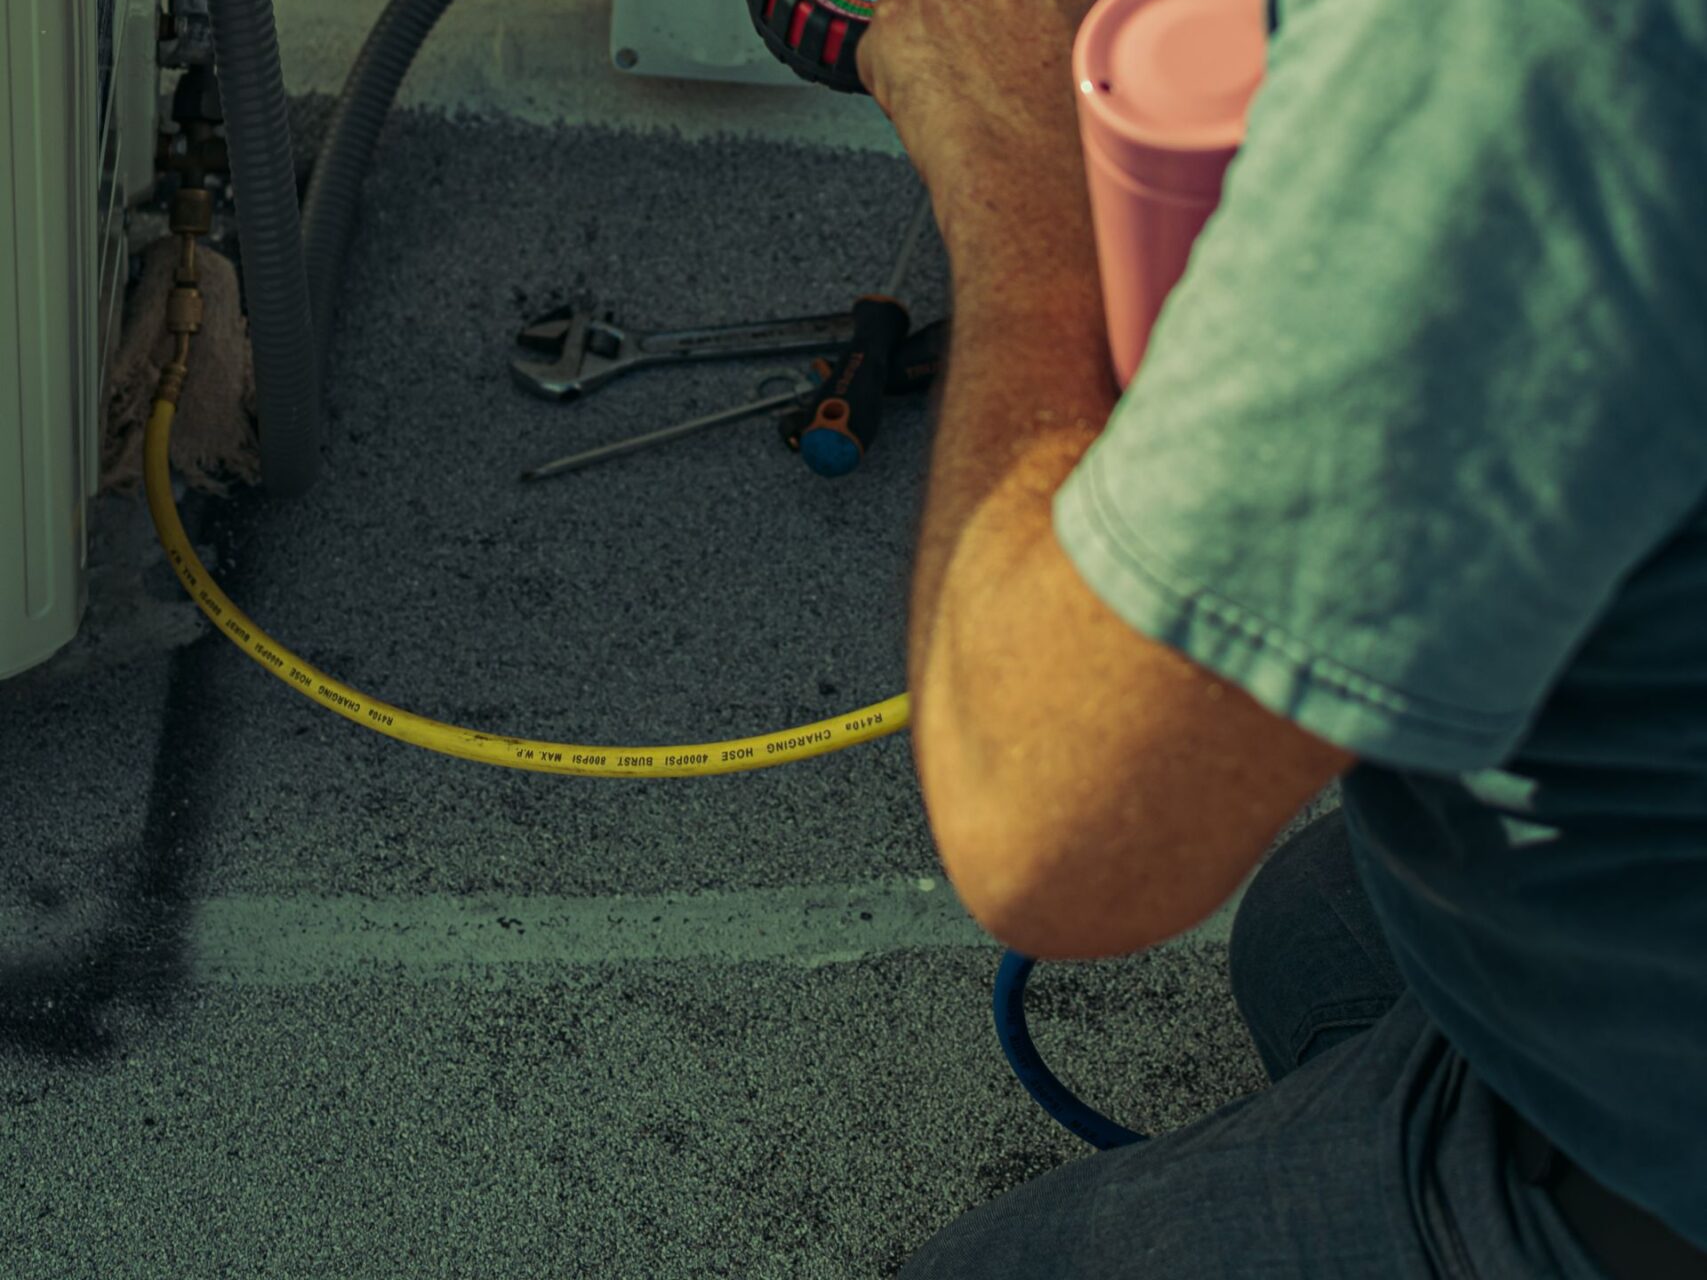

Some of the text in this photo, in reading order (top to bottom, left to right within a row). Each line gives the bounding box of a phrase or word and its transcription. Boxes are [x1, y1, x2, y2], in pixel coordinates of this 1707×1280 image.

[224, 618, 251, 642] BURST
[288, 667, 313, 687] HOSE
[317, 684, 361, 712] CHARGING
[367, 708, 394, 726] R410a
[844, 712, 883, 731] R410a
[765, 729, 831, 753] CHARGING
[571, 754, 607, 766] 800PSI
[616, 756, 654, 767] BURST
[664, 753, 709, 766] 4000PSI
[721, 747, 754, 761] HOSE
